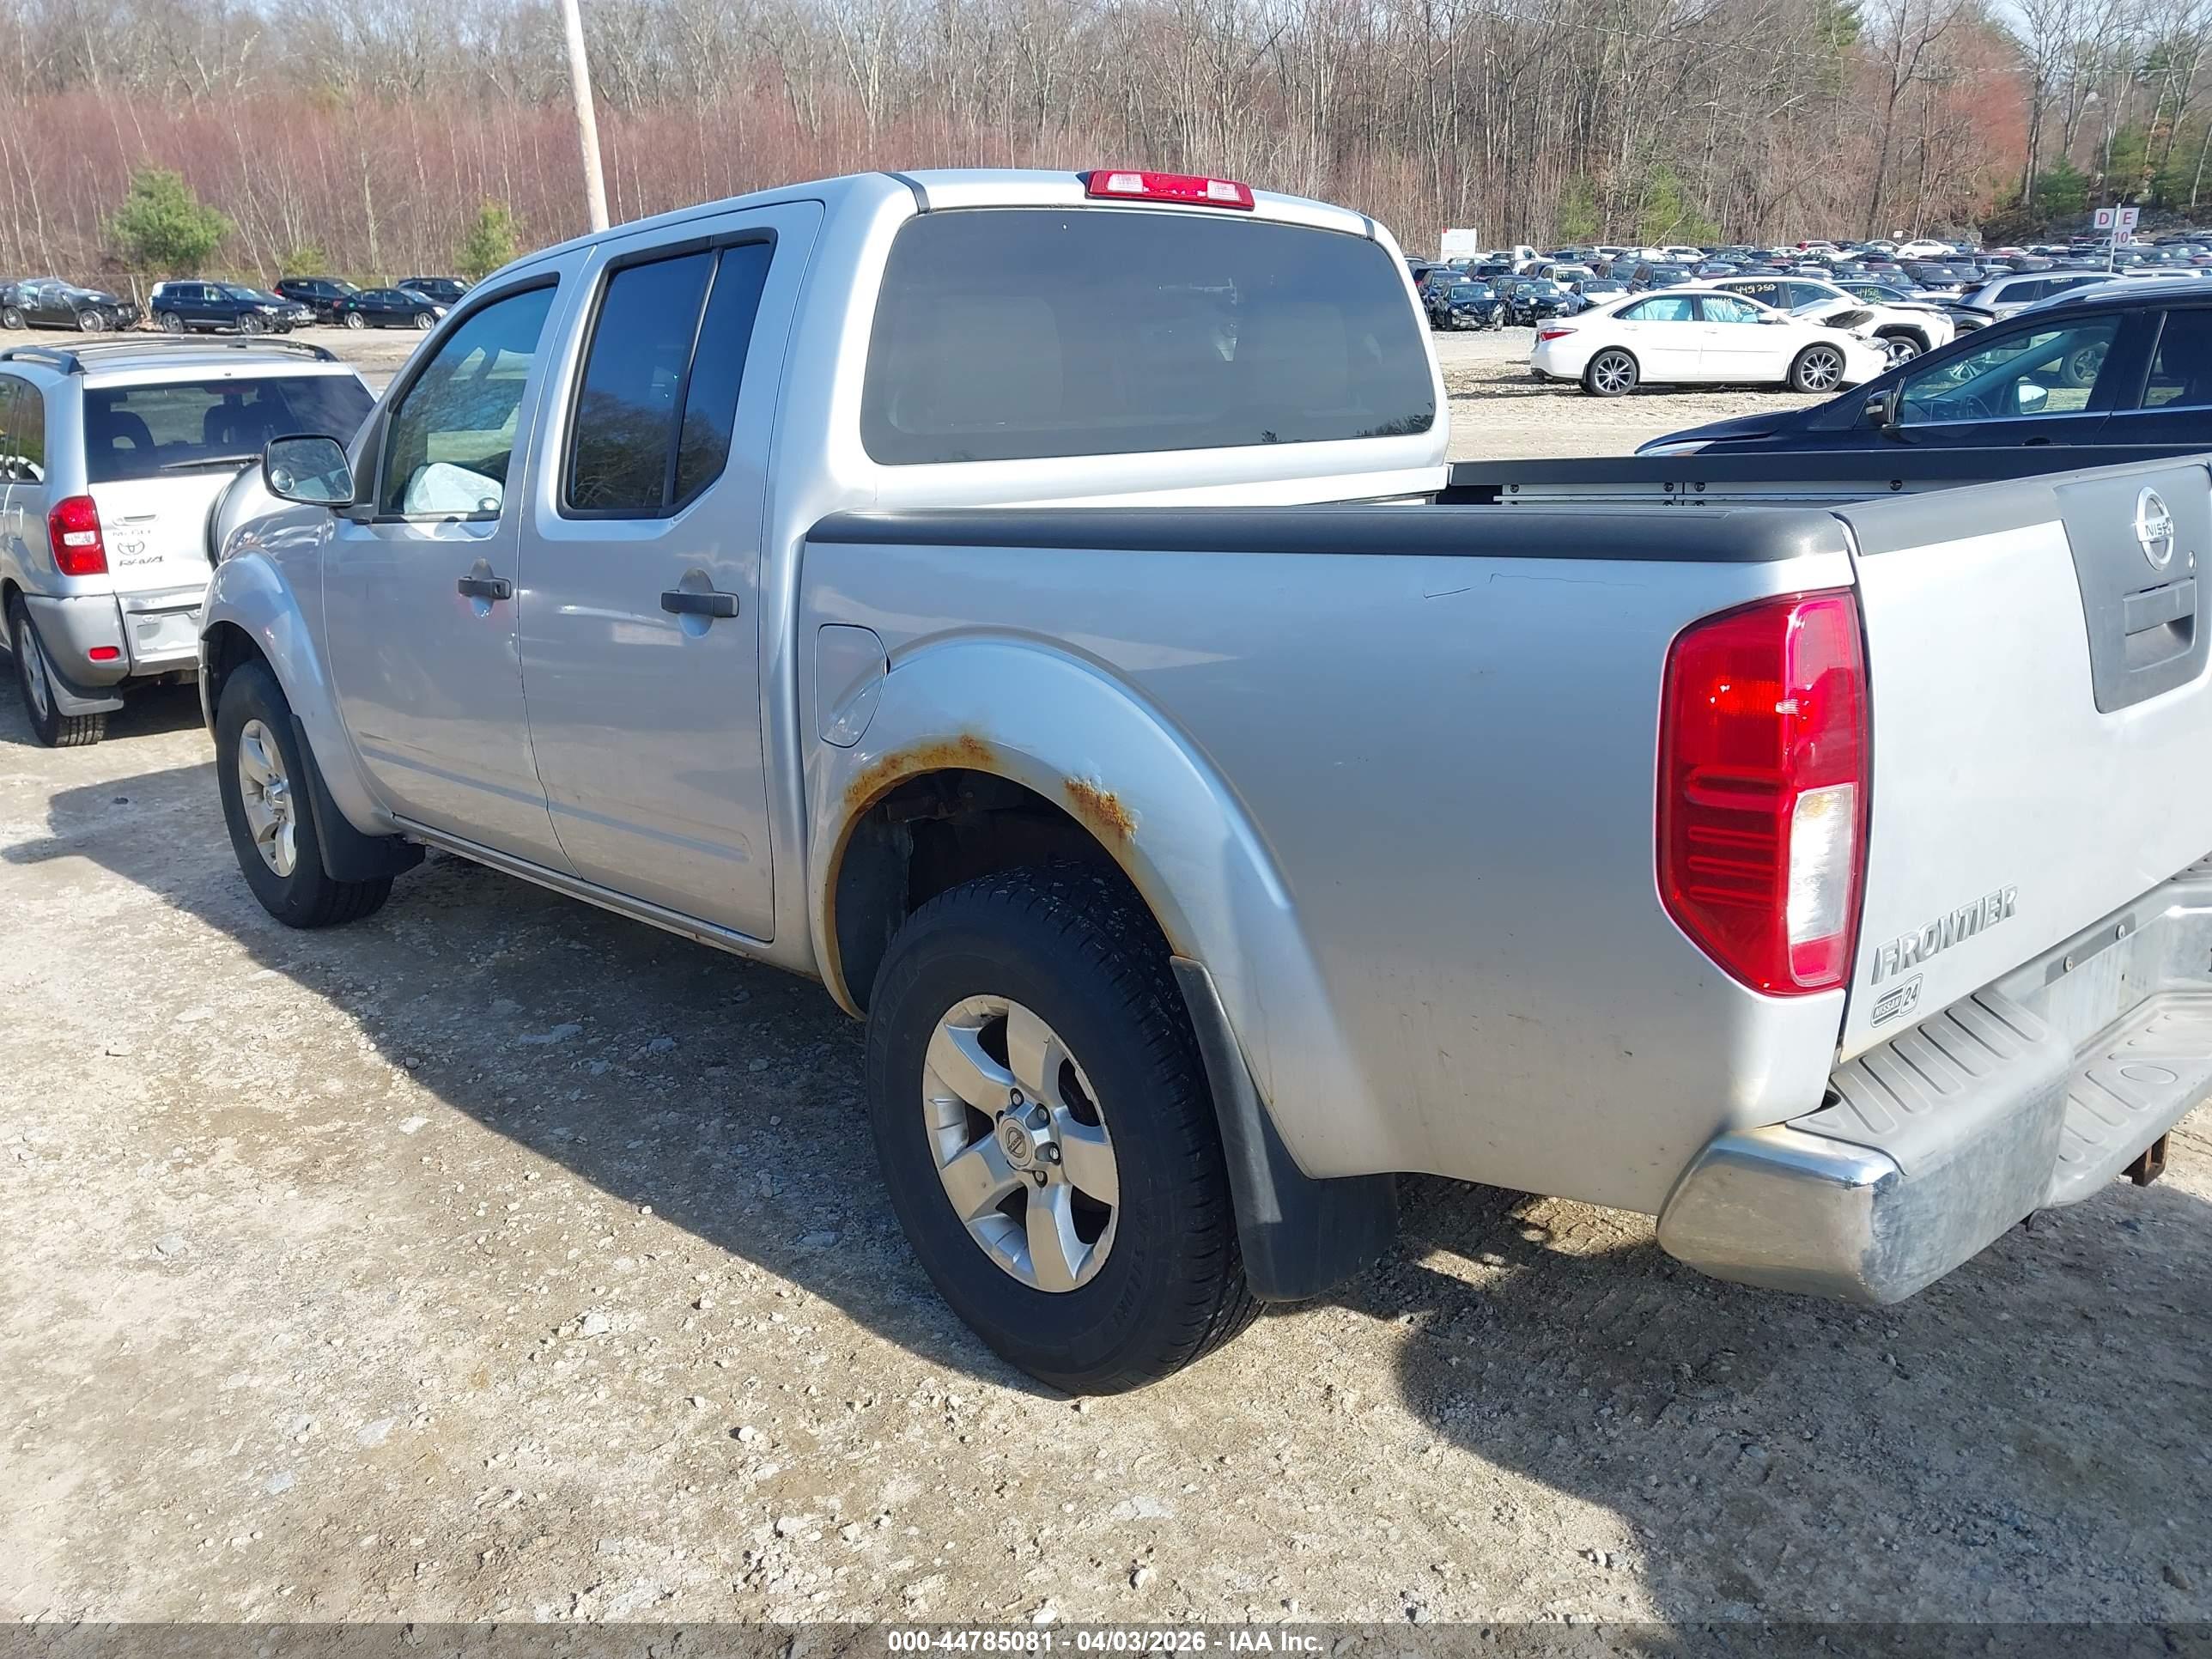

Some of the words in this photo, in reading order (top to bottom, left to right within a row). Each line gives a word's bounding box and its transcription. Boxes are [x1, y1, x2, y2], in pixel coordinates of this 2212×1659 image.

[2099, 212, 2109, 224] D
[2124, 212, 2133, 224] E
[2114, 232, 2129, 243] 10
[1870, 883, 2018, 986] FRONTIER
[1874, 994, 1902, 1018] NISSAN
[1904, 983, 1918, 1006] 24
